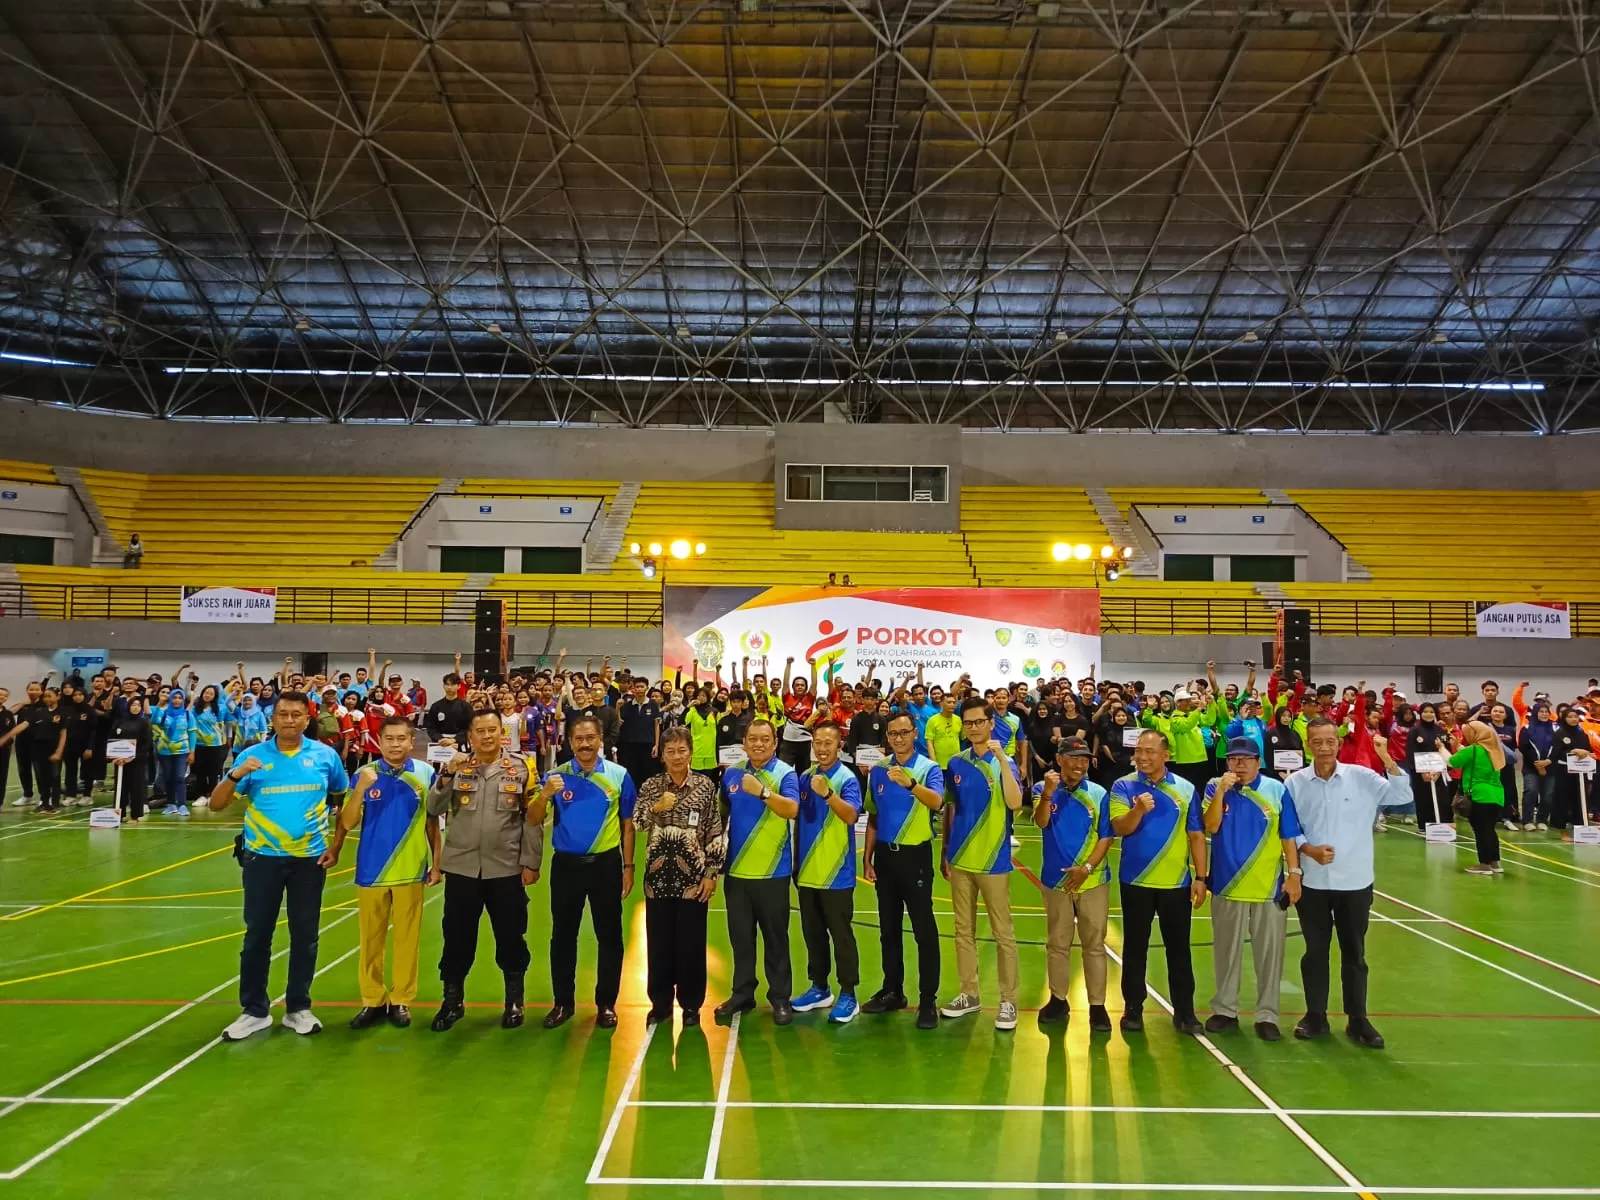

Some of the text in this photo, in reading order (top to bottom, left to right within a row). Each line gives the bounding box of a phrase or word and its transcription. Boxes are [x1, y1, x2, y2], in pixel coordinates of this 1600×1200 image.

[187, 598, 271, 608] SUKSES RAIH JUARA
[1482, 613, 1561, 624] JANGAN PUTUS ASA
[857, 627, 962, 646] PORKOT
[856, 648, 962, 658] PEKAN OLAHRAGA KOTA
[888, 660, 962, 669] YOGYKARTA
